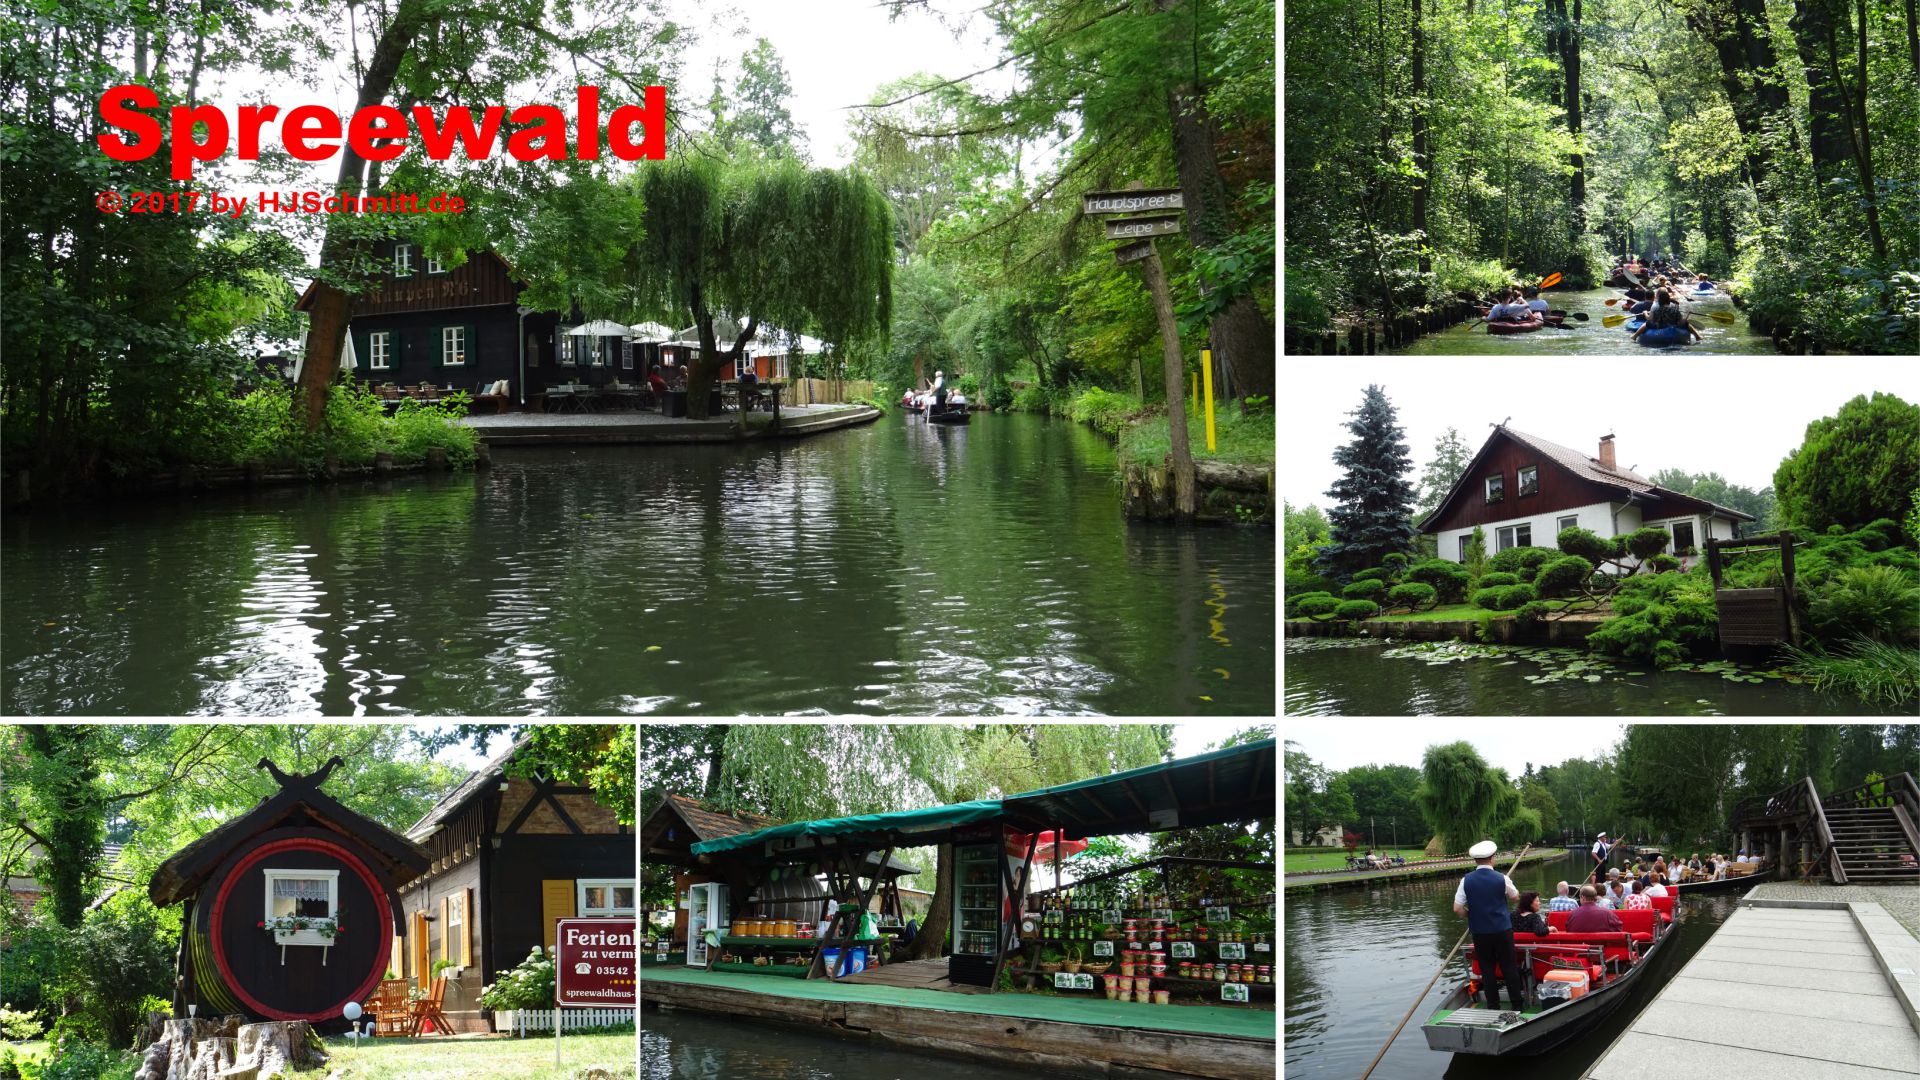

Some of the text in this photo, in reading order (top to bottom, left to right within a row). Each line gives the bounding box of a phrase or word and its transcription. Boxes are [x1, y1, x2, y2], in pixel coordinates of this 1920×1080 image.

[1088, 196, 1165, 211] Hauptspree
[1114, 223, 1153, 236] Leipe
[582, 950, 598, 959] zu
[596, 966, 629, 975] 03542
